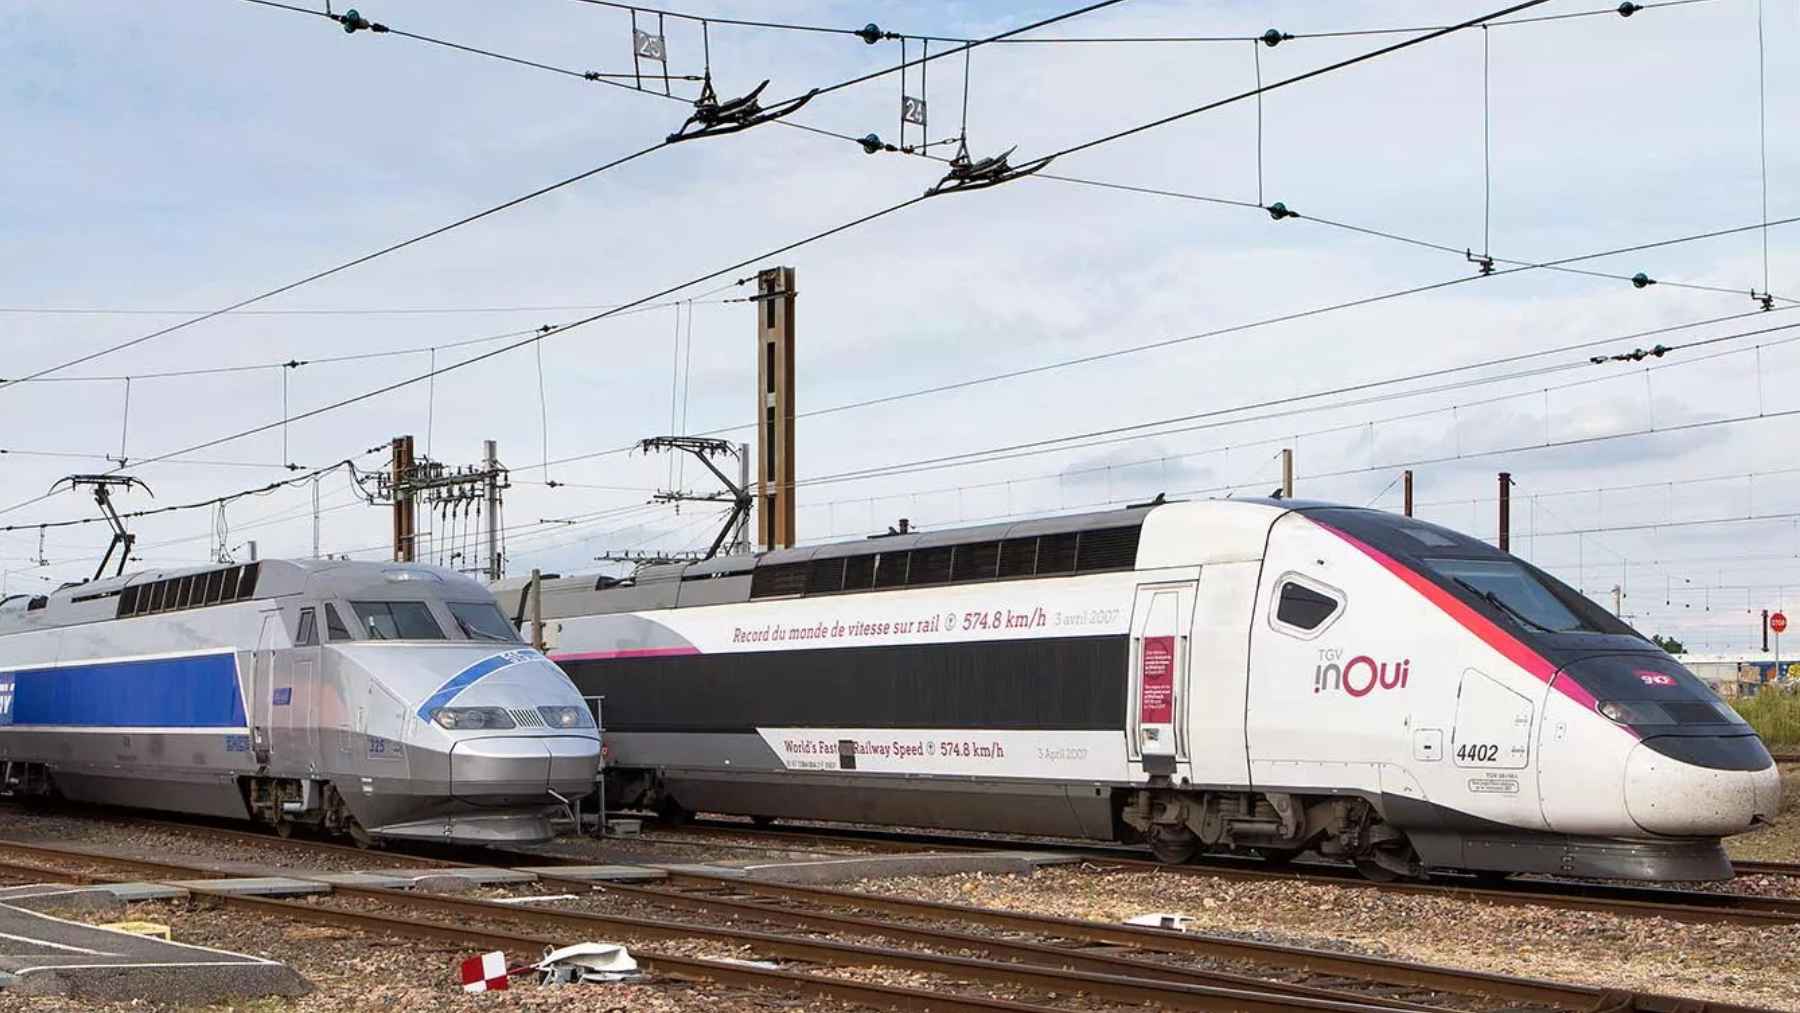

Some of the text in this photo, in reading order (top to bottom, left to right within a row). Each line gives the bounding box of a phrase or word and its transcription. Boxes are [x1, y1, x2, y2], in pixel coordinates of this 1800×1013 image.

[733, 625, 769, 643] Record
[772, 624, 785, 640] du
[788, 622, 827, 640] monde
[831, 620, 845, 638] de
[848, 620, 890, 637] vitesse
[893, 621, 914, 635] sur
[917, 614, 939, 633] rail
[962, 610, 1002, 631] 574.8
[1005, 607, 1047, 629] km/h
[1318, 648, 1343, 661] TGV
[784, 740, 817, 753] World's
[852, 741, 890, 757] Railway
[892, 742, 924, 758] Speed
[940, 742, 970, 757] 574.8
[972, 743, 1004, 758] km/h
[1456, 744, 1499, 761] 4402
